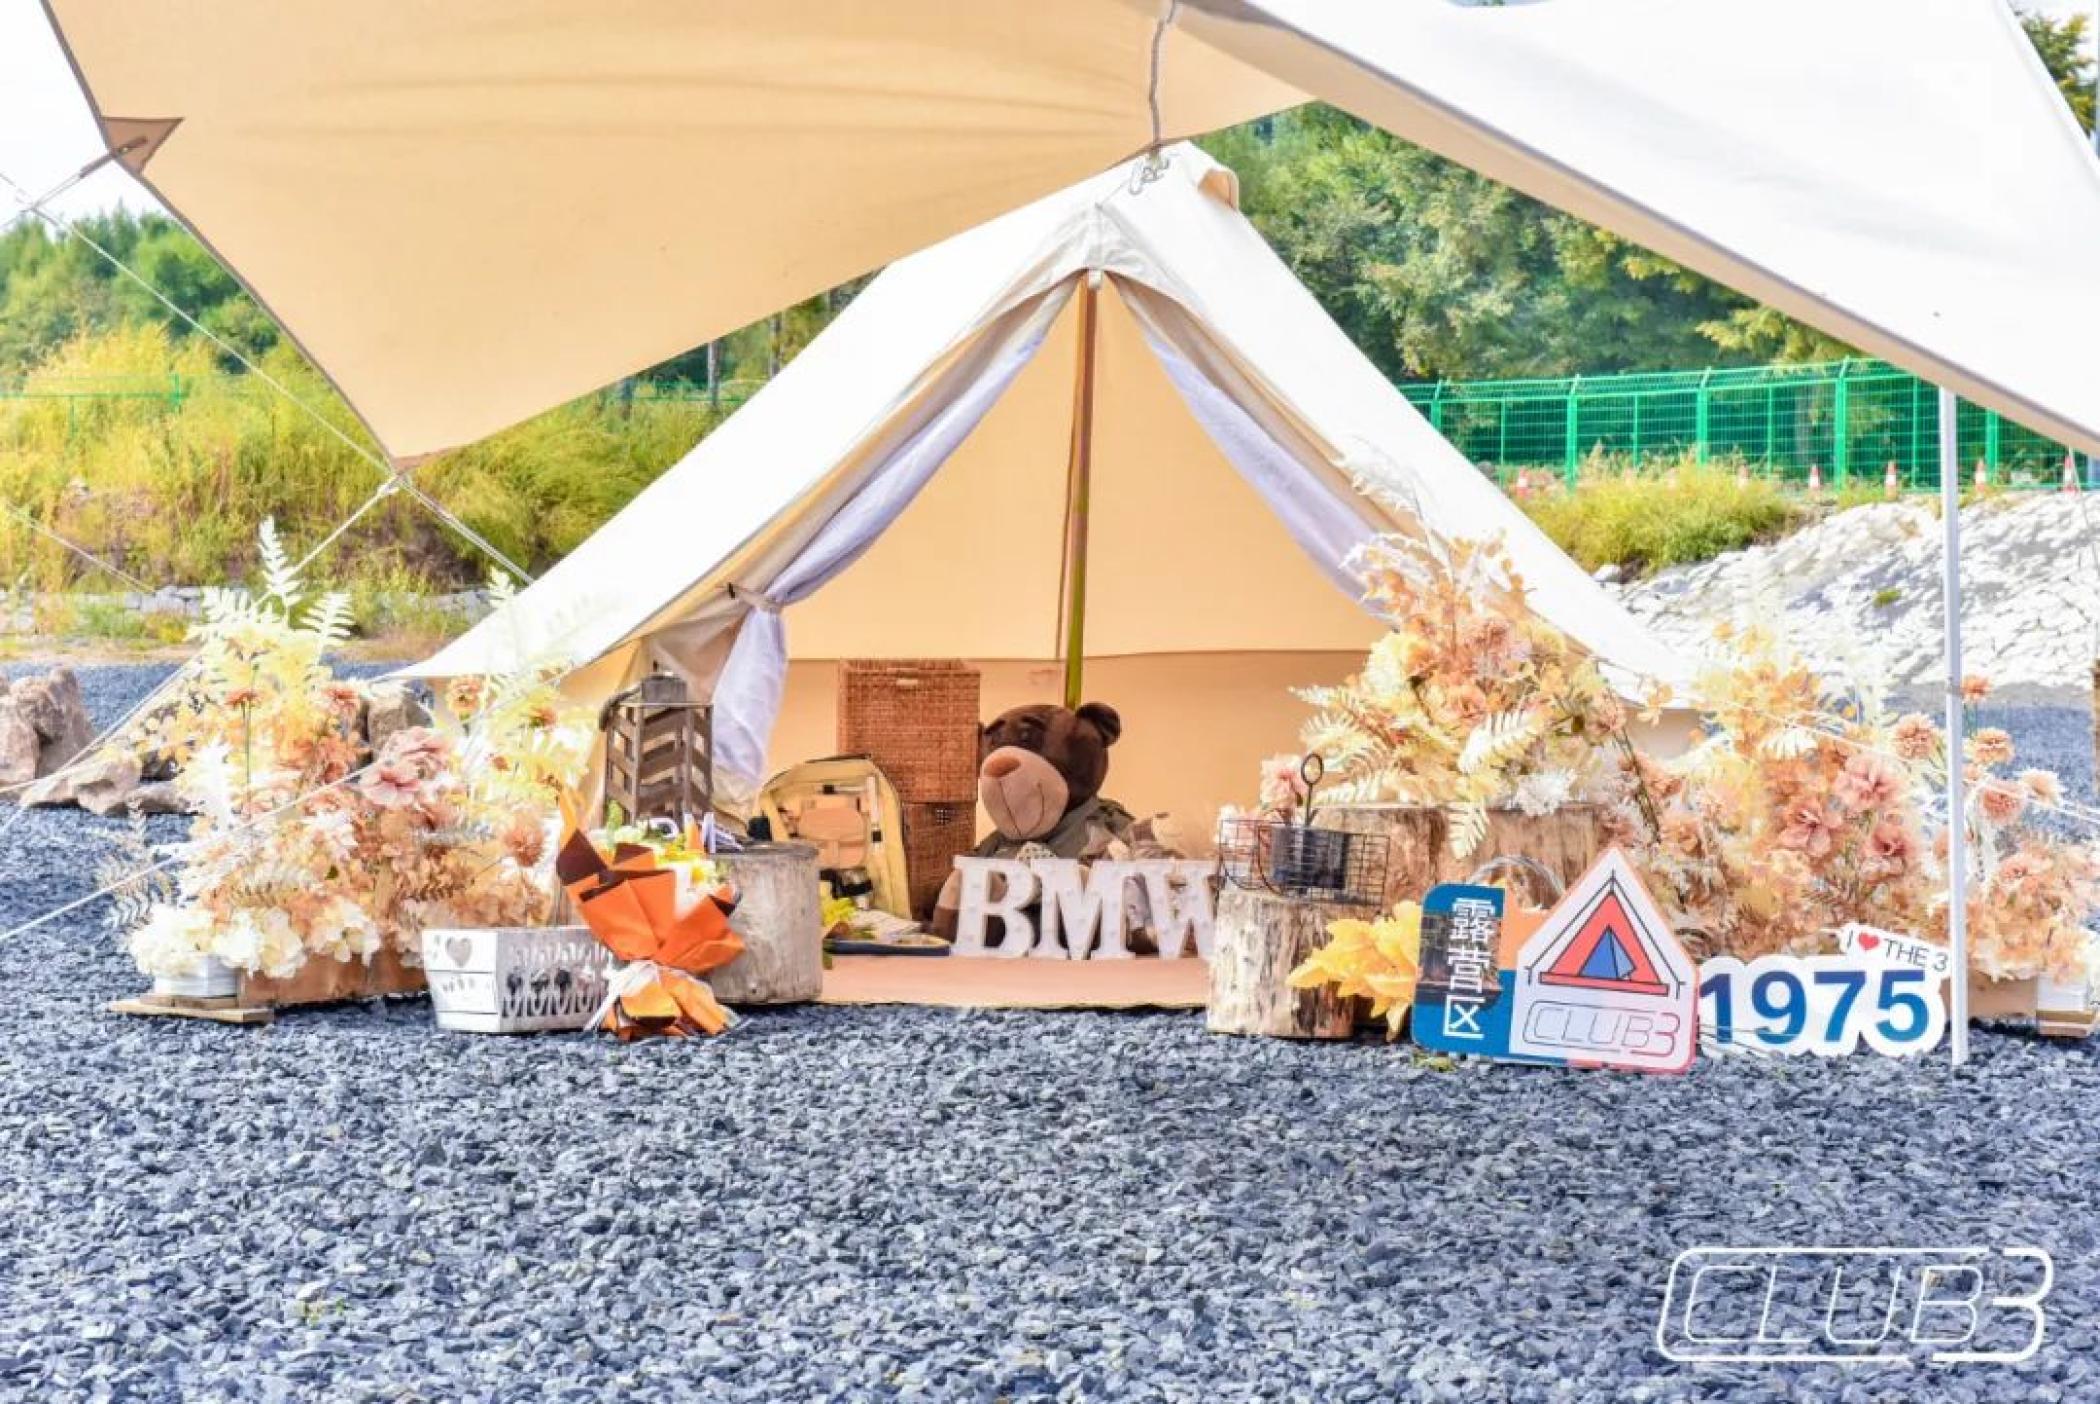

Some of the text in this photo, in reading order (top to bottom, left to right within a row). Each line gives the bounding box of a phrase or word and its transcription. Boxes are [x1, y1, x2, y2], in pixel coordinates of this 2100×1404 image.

[950, 855, 1217, 960] BMW
[1443, 898, 1496, 1039] 露营区
[1846, 929, 1949, 973] I THE 3
[1534, 1006, 1681, 1058] CLUB3
[1699, 969, 1930, 1045] 1975
